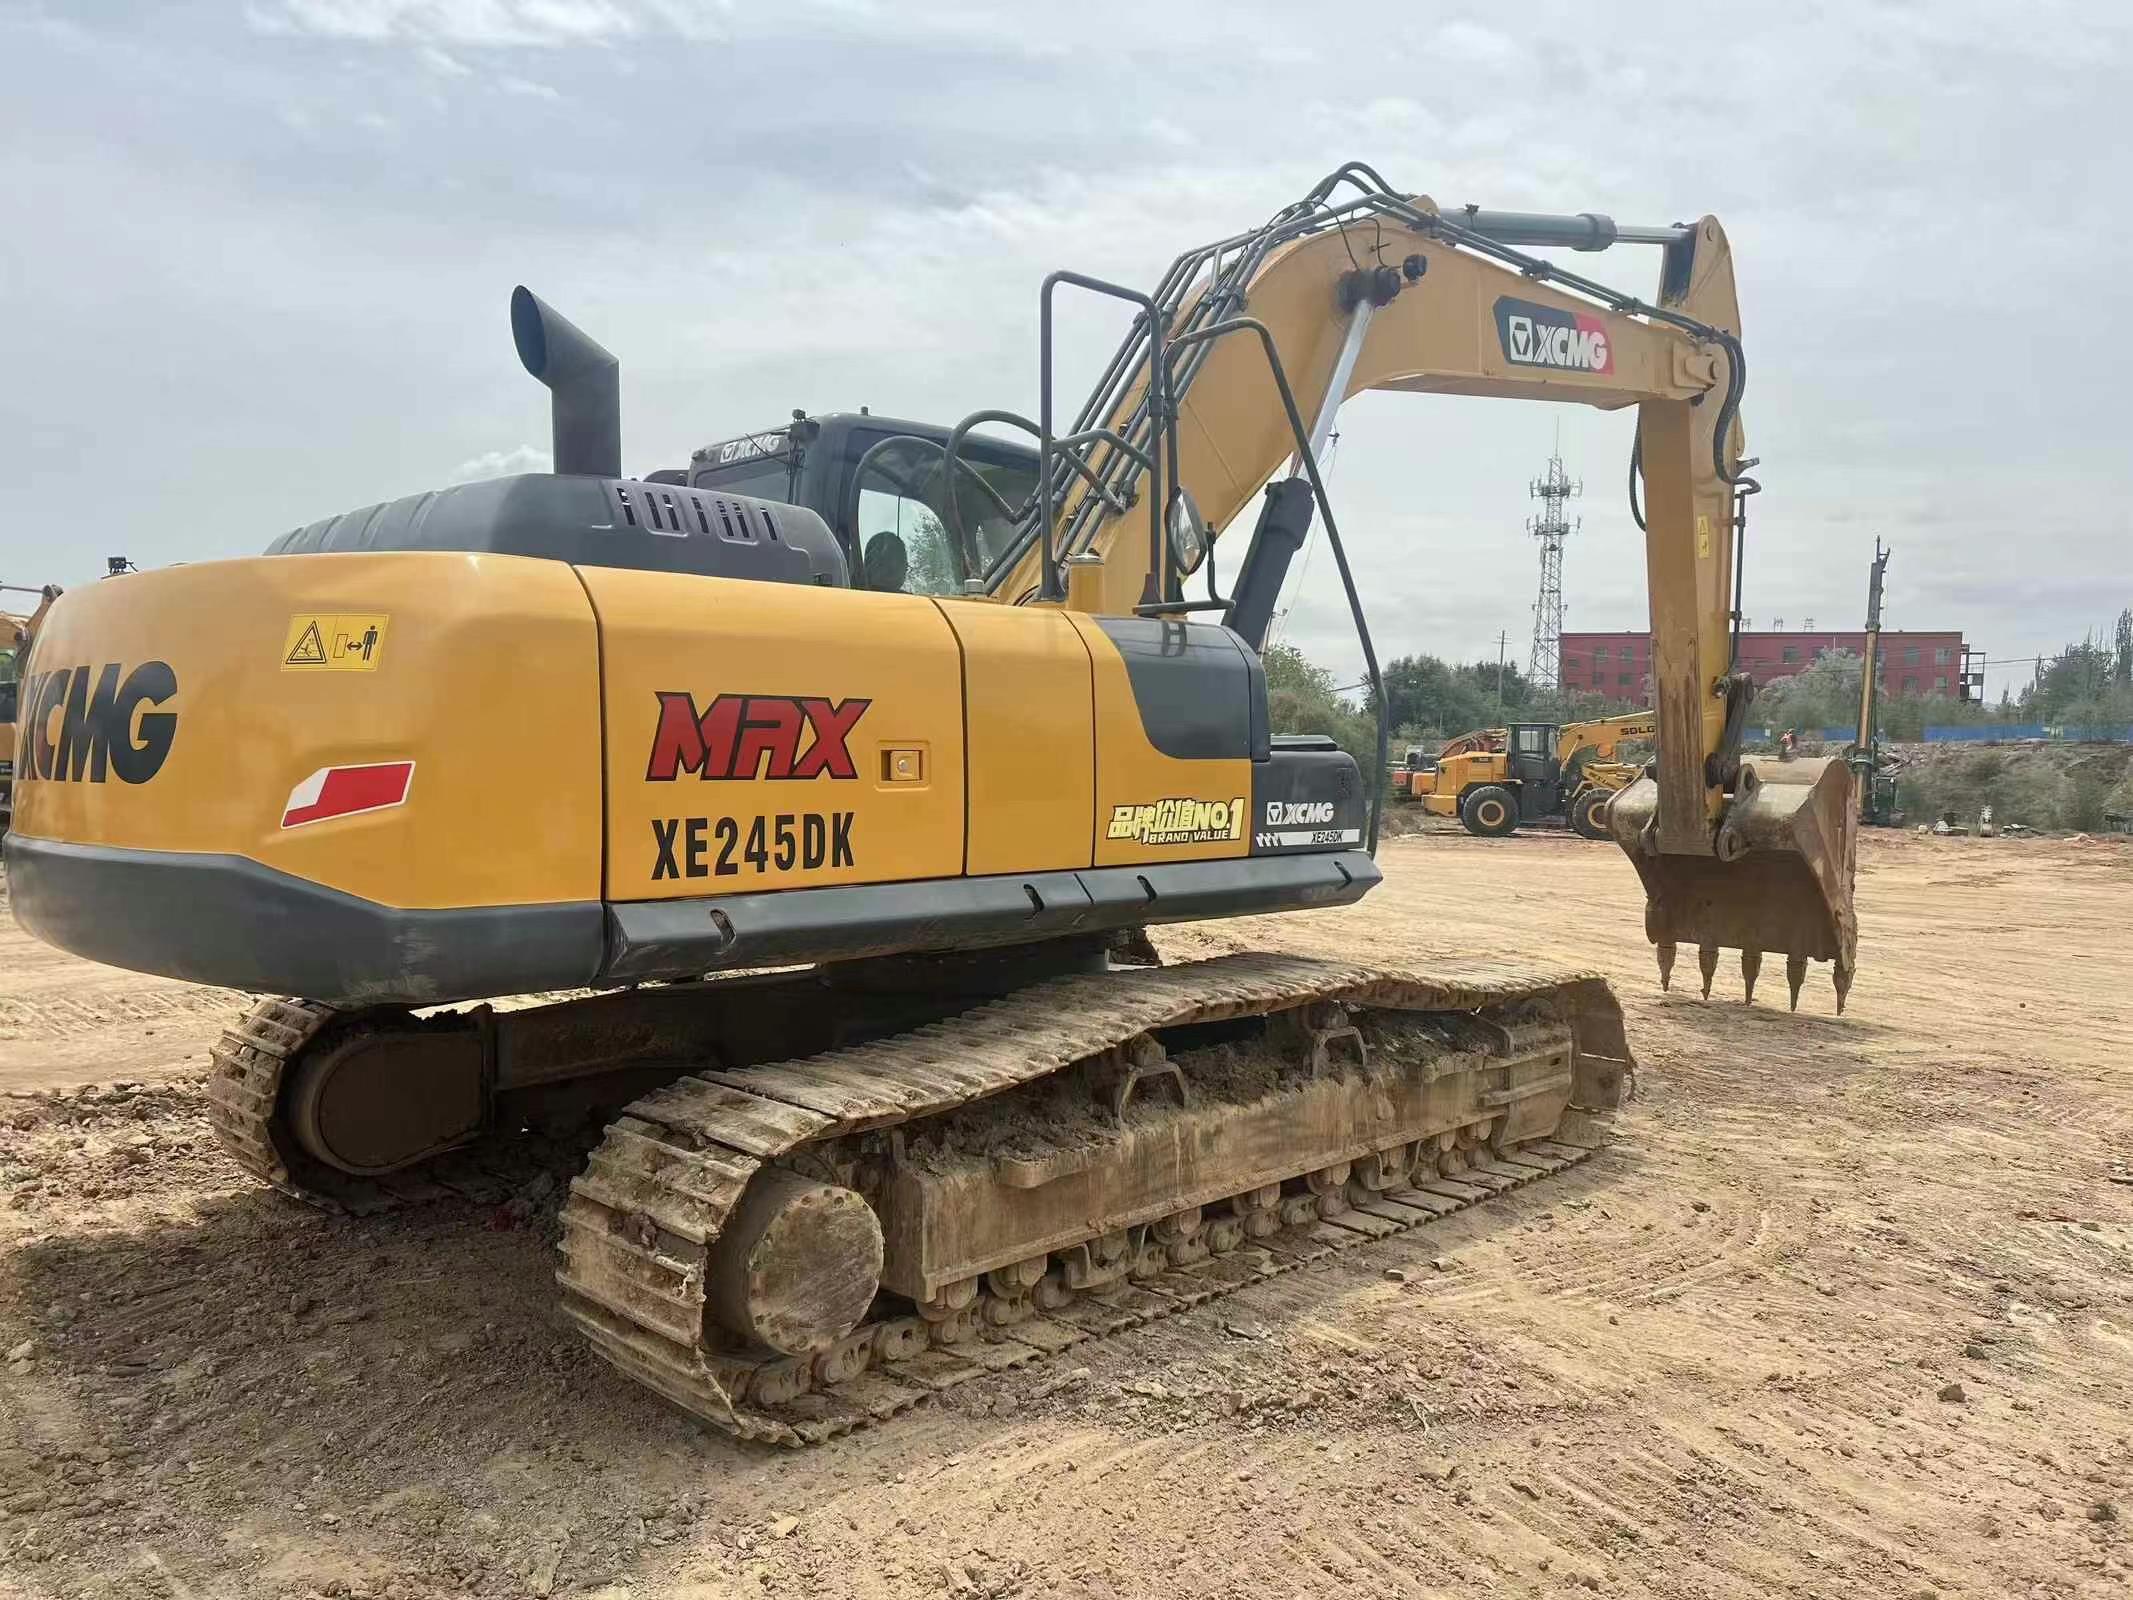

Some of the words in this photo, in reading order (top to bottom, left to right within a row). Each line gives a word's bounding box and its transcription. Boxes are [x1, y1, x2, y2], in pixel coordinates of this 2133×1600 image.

[1533, 323, 1608, 370] XCMG
[18, 660, 178, 784] XCMG
[645, 691, 873, 782] MAX
[1149, 831, 1189, 844] BRAND
[1193, 829, 1229, 841] VALUE
[1282, 802, 1334, 825] XCMG
[1312, 830, 1343, 844] XE245DK
[651, 812, 855, 881] XE245DK
